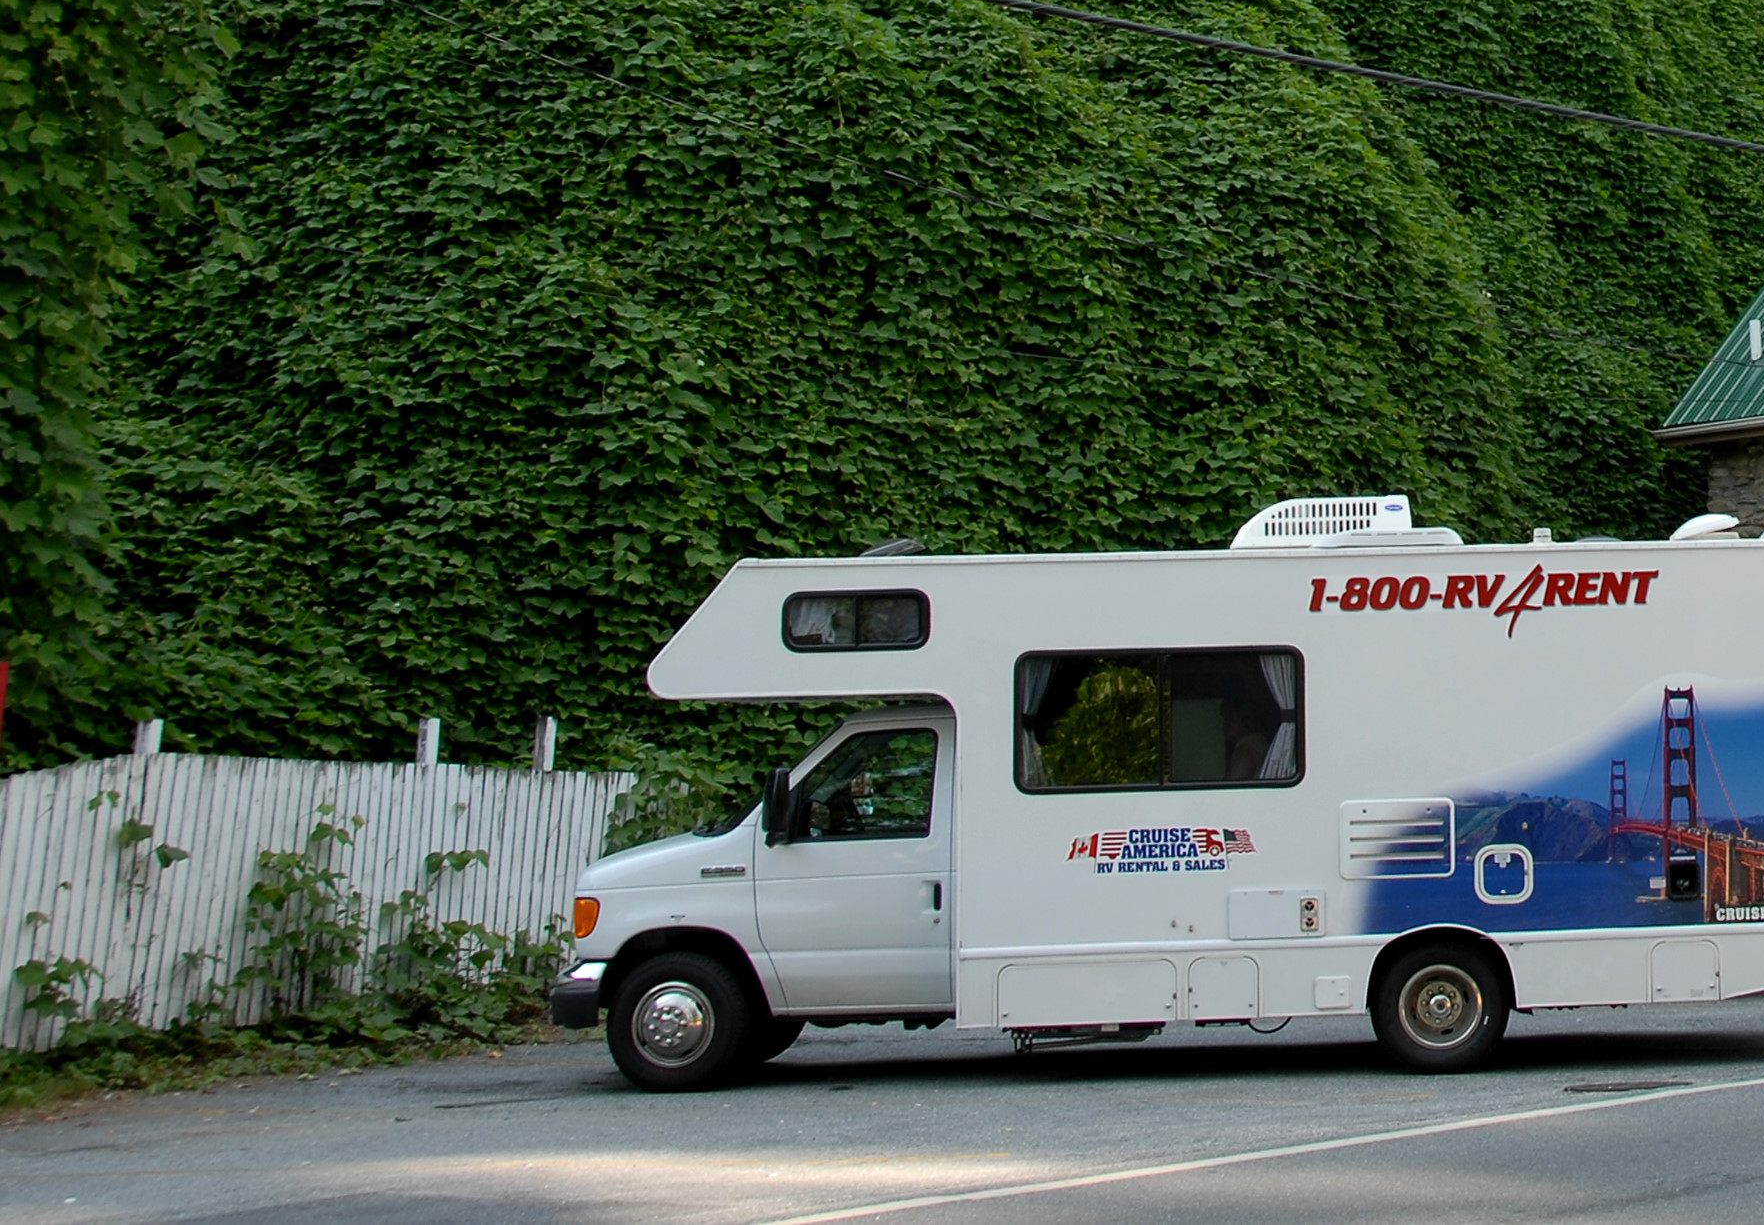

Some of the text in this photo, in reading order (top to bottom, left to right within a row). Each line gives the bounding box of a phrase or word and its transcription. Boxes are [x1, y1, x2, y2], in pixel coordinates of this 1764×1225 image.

[1128, 828, 1191, 844] CRUISE
[1121, 843, 1199, 860] AMERICA
[1097, 859, 1226, 874] RV RENTAL & SALES
